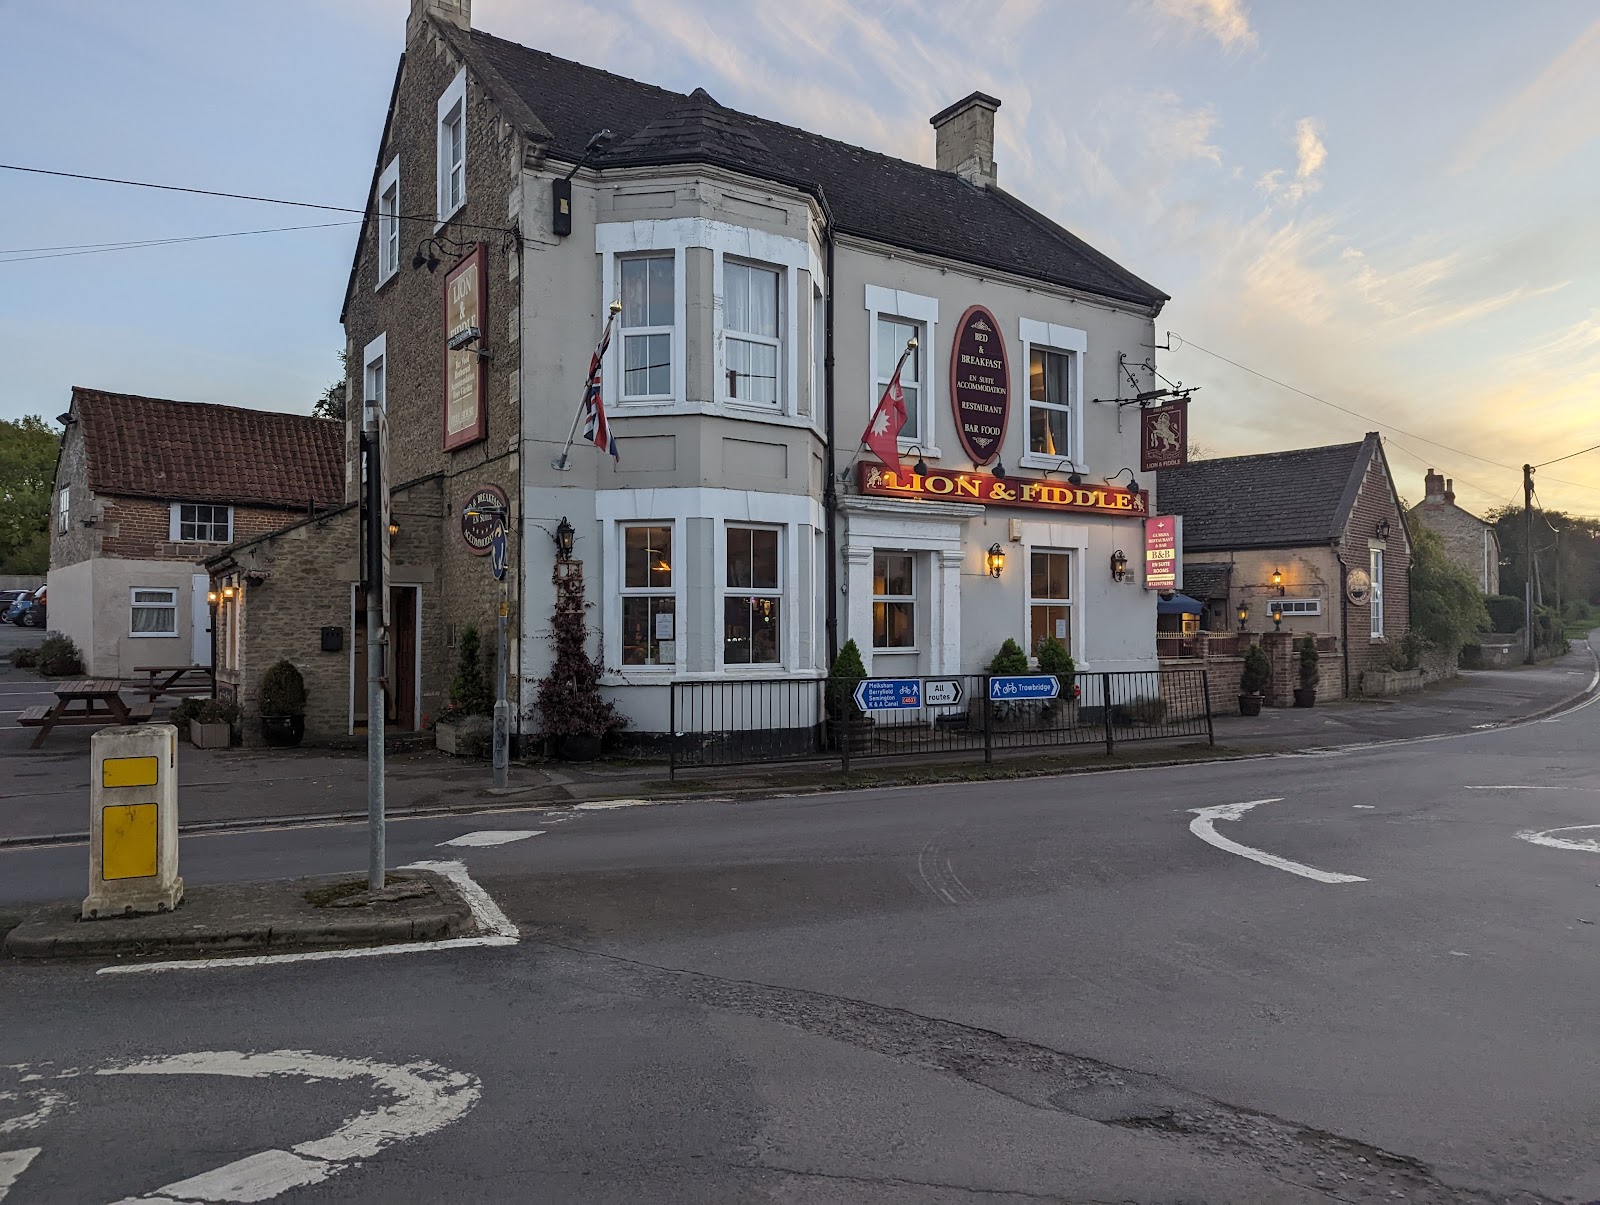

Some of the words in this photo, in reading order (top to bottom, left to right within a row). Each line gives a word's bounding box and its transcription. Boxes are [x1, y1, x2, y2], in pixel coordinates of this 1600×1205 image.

[453, 273, 472, 304] LION
[460, 301, 466, 320] &
[975, 333, 988, 343] BED
[979, 346, 984, 354] &
[961, 355, 1002, 369] BREAKFAST
[980, 376, 994, 384] SUITE
[957, 381, 1006, 394] ACCOMMODATION
[962, 401, 1002, 414] RESTAURANT
[965, 424, 978, 433] BAR
[981, 426, 1000, 436] FOOD
[1163, 459, 1180, 467] FIDDLE
[884, 471, 982, 498] LION
[989, 482, 1017, 501] &
[1020, 484, 1132, 510] FIDDLE
[1152, 551, 1170, 559] B&B
